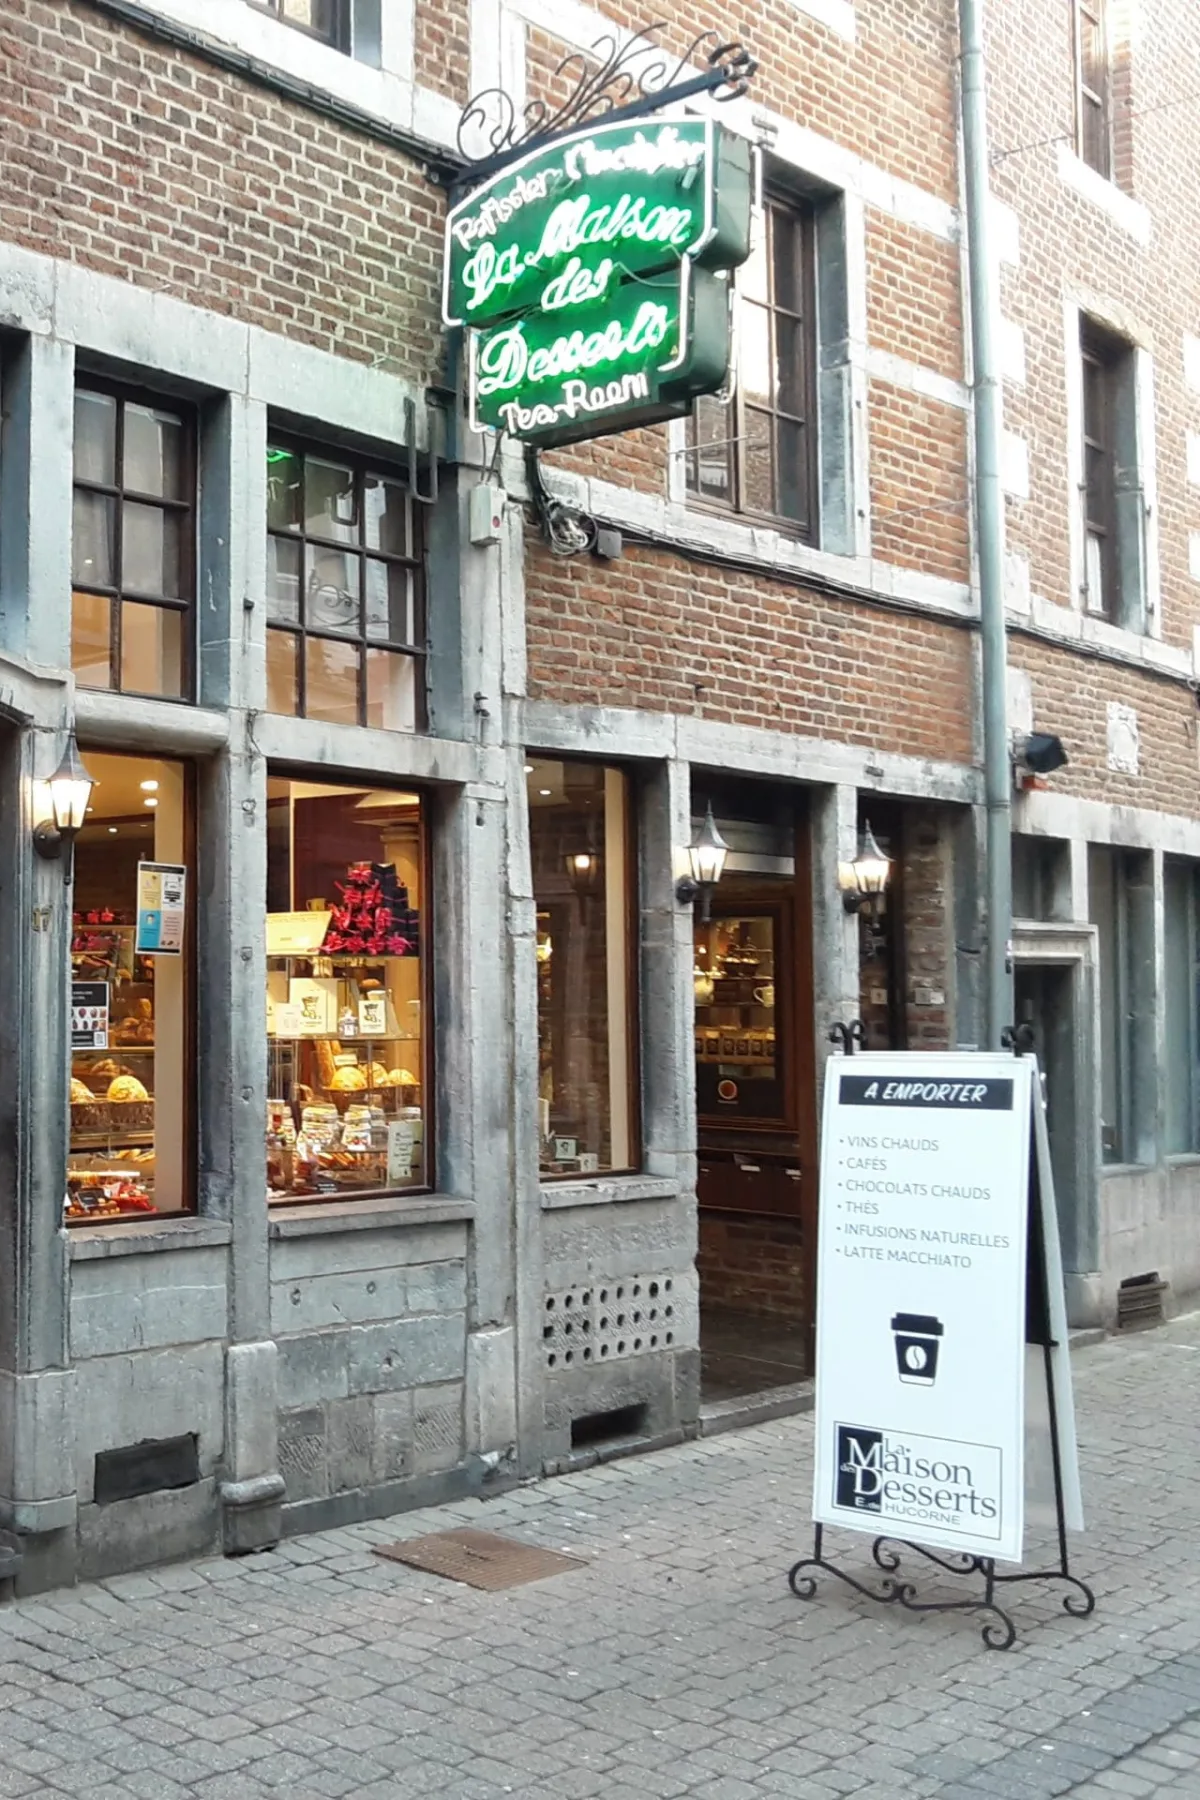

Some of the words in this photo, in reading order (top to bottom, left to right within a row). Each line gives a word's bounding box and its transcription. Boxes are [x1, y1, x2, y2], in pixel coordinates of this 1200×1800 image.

[463, 242, 525, 310] La
[524, 194, 692, 266] Maison
[541, 257, 613, 312] des
[478, 301, 668, 395] Desserts
[863, 1082, 878, 1099] A
[882, 1083, 988, 1102] EMPORTER
[847, 1136, 878, 1148] VINS
[881, 1137, 939, 1151] CHAUDS
[846, 1156, 887, 1171] CAFÉS
[846, 1179, 928, 1196] CHOCOLATS
[931, 1184, 991, 1200] CHAUDS
[845, 1200, 880, 1215] THÉS
[844, 1223, 917, 1240] INFUSIONS
[920, 1229, 1010, 1248] NATURELLES
[844, 1246, 884, 1260] LATTE
[887, 1250, 972, 1268] MACCHIATO
[846, 1436, 974, 1487] Maison
[853, 1465, 997, 1518] Desserts
[885, 1503, 960, 1525] HUCORNE
